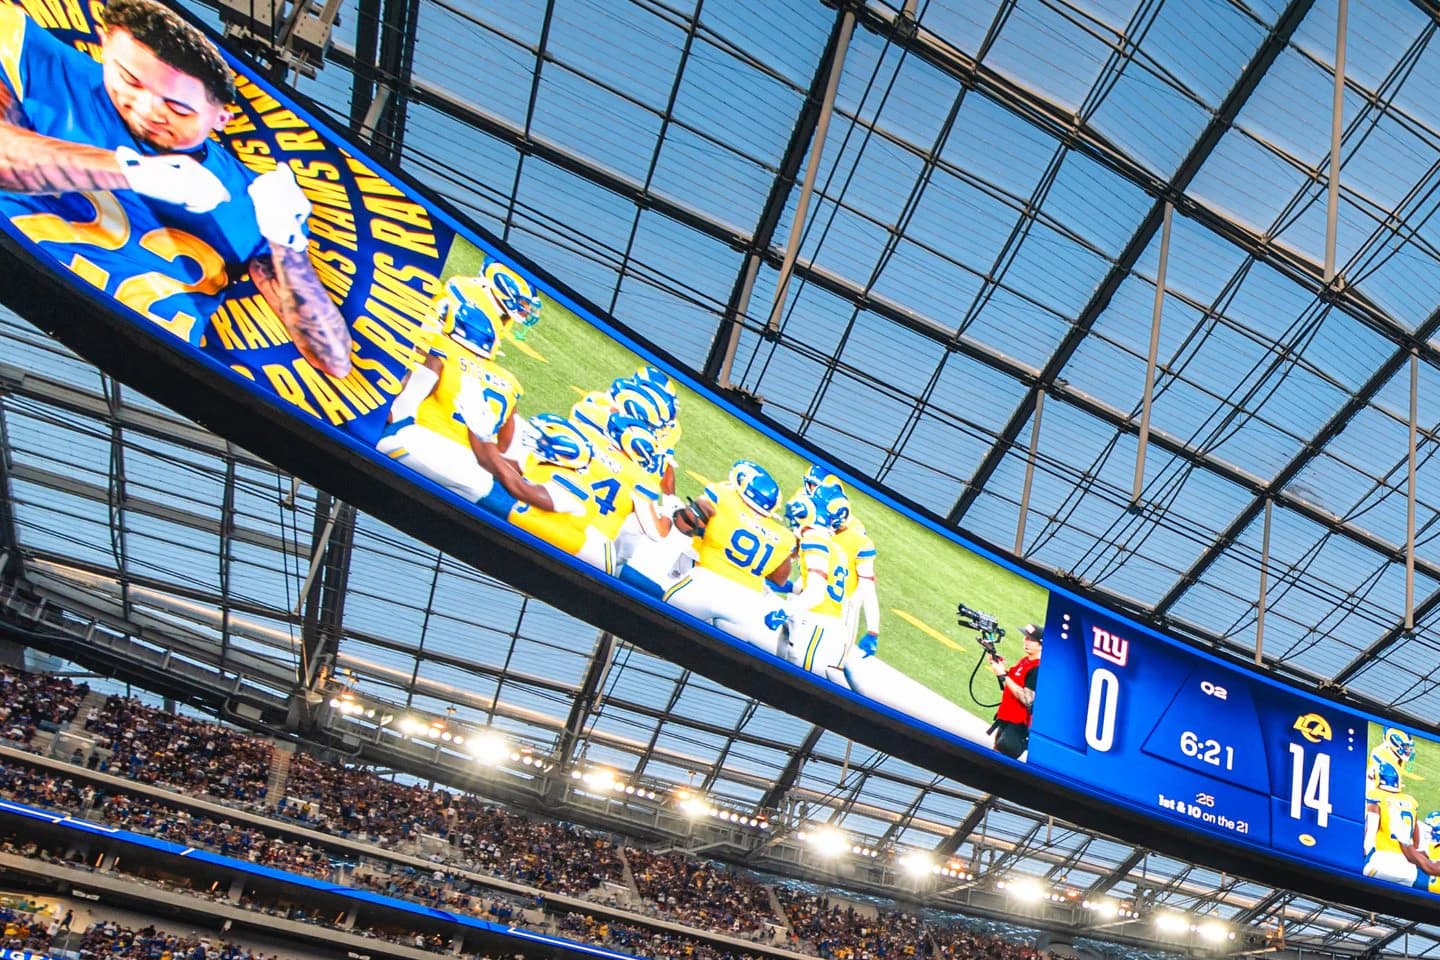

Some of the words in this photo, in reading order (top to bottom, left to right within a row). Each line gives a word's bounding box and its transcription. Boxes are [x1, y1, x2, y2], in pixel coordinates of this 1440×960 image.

[724, 526, 775, 577] 91
[1084, 668, 1120, 753] 0
[1200, 680, 1228, 700] Q2
[1180, 731, 1235, 771] 6:21
[1289, 742, 1333, 828] 14
[1158, 794, 1176, 811] 1st
[1176, 800, 1188, 813] &
[1188, 804, 1202, 819] 10
[1202, 811, 1217, 823] on
[1217, 813, 1236, 830] the
[1236, 821, 1249, 834] 21
